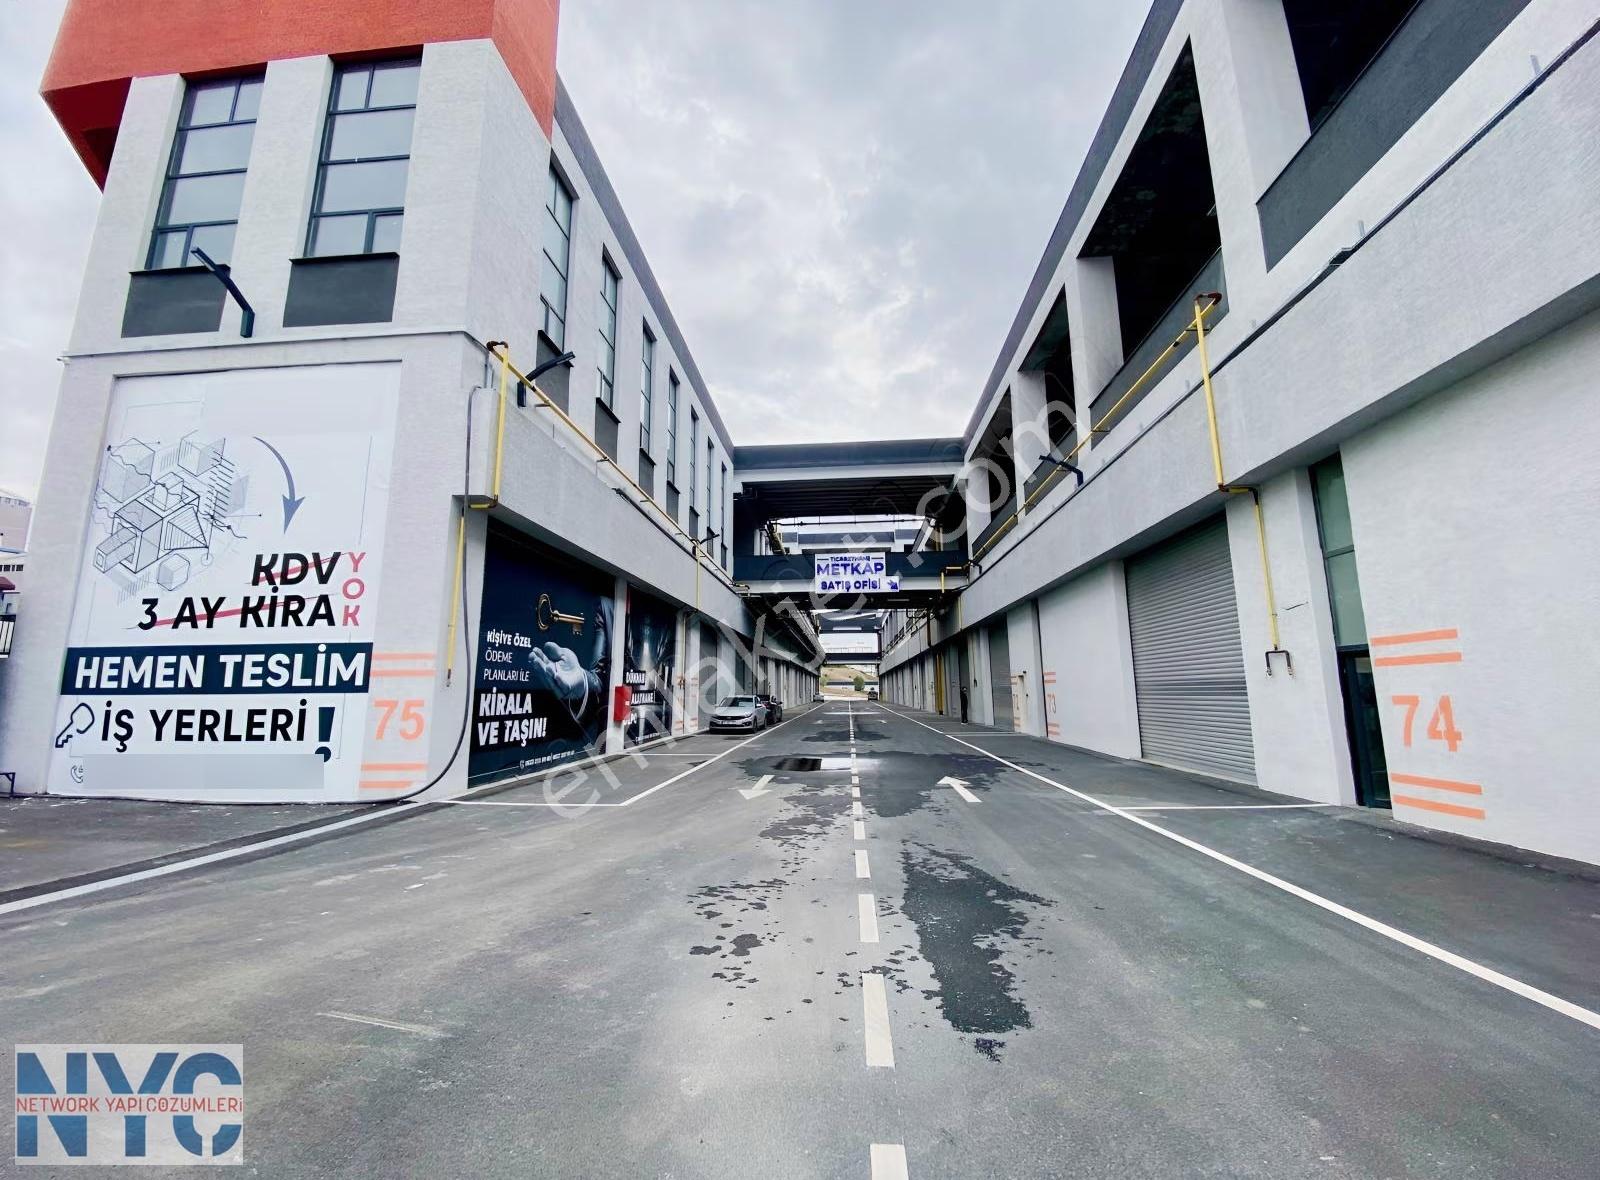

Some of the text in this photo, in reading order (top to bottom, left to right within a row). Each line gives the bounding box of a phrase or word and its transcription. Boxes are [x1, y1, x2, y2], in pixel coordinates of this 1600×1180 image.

[252, 552, 341, 586] KDV
[816, 562, 884, 576] METKAP
[342, 552, 366, 626] YOK
[821, 580, 851, 592] SATIŞ
[138, 586, 336, 631] 3 AY KİRA
[485, 646, 513, 663] ÖDEME
[513, 632, 531, 647] ÖZEL
[75, 644, 367, 689] HEMEN TESLİM
[484, 668, 519, 680] PLANLARI
[479, 686, 532, 716] KİRALA
[102, 700, 134, 752] İŞ
[374, 701, 425, 740] 75
[478, 717, 547, 747] VE TAŞIN!
[1392, 695, 1462, 752] 74
